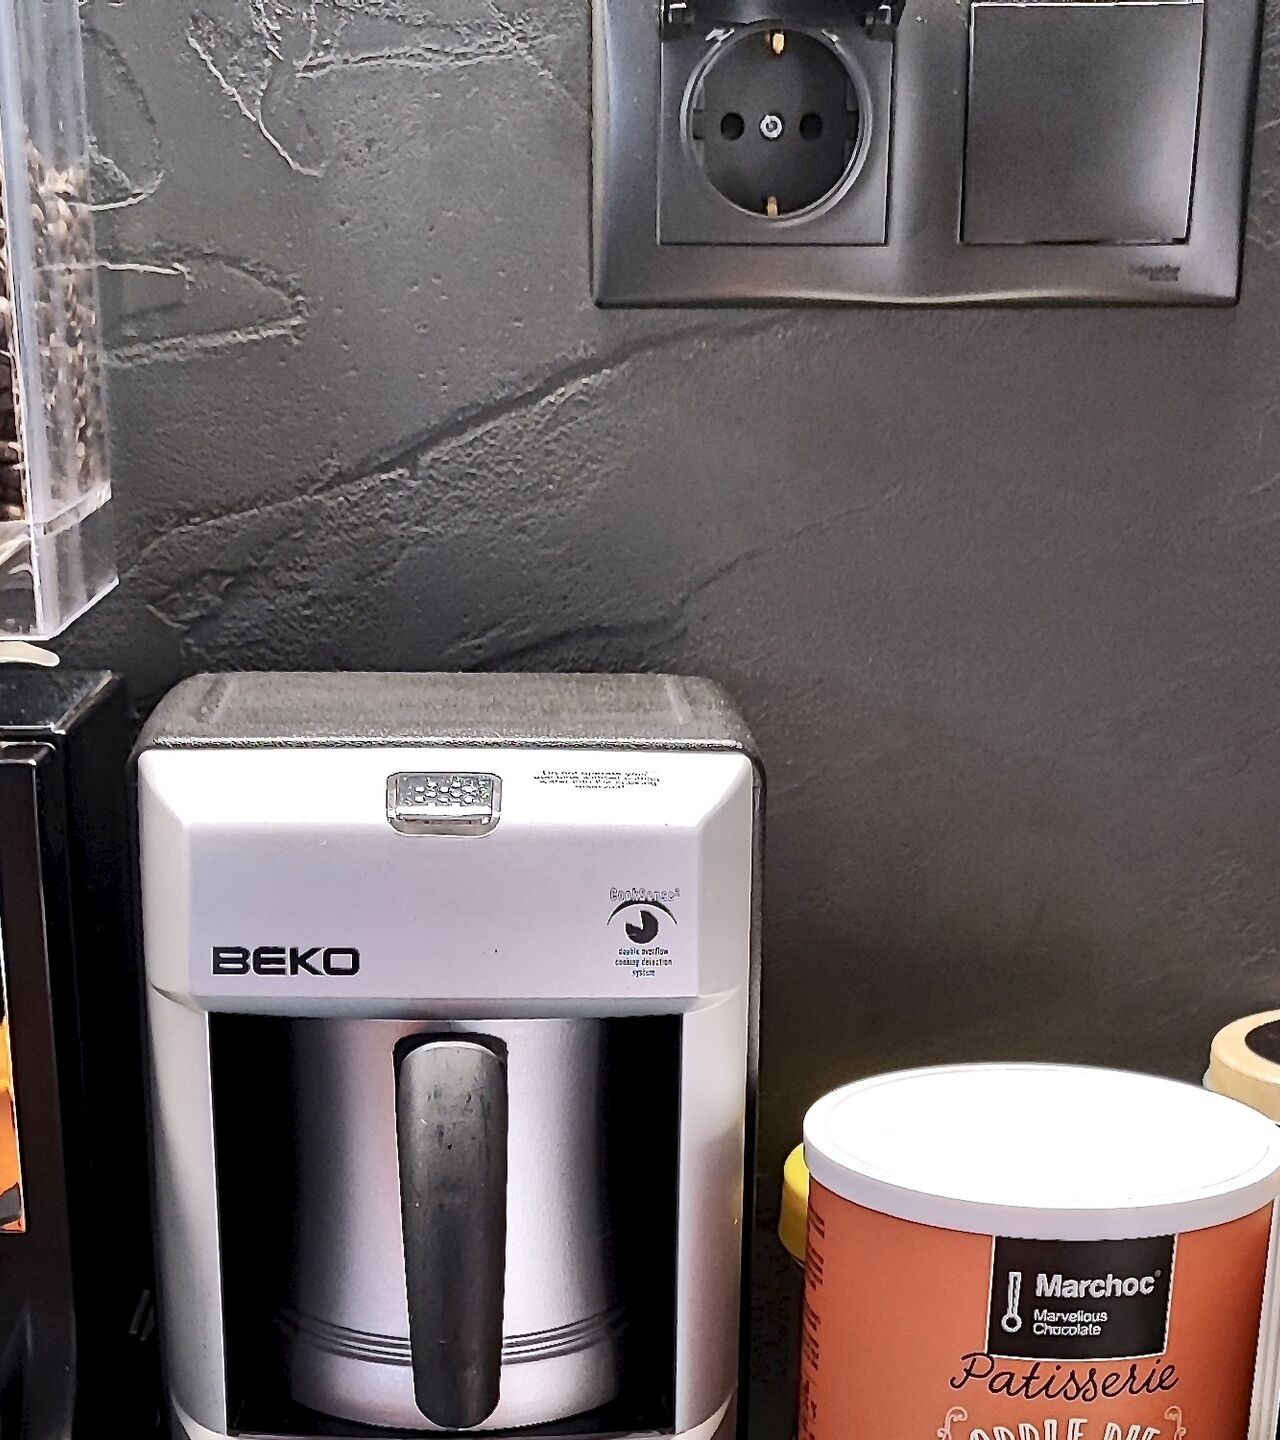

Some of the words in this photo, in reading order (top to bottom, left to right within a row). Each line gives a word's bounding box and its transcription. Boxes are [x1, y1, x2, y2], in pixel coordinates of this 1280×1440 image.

[212, 946, 360, 976] BEKO
[1035, 1273, 1155, 1298] Marchoc
[1033, 1308, 1109, 1323] Marvellous
[1032, 1322, 1102, 1336] Chocolate
[949, 1352, 1180, 1402] Patisserie
